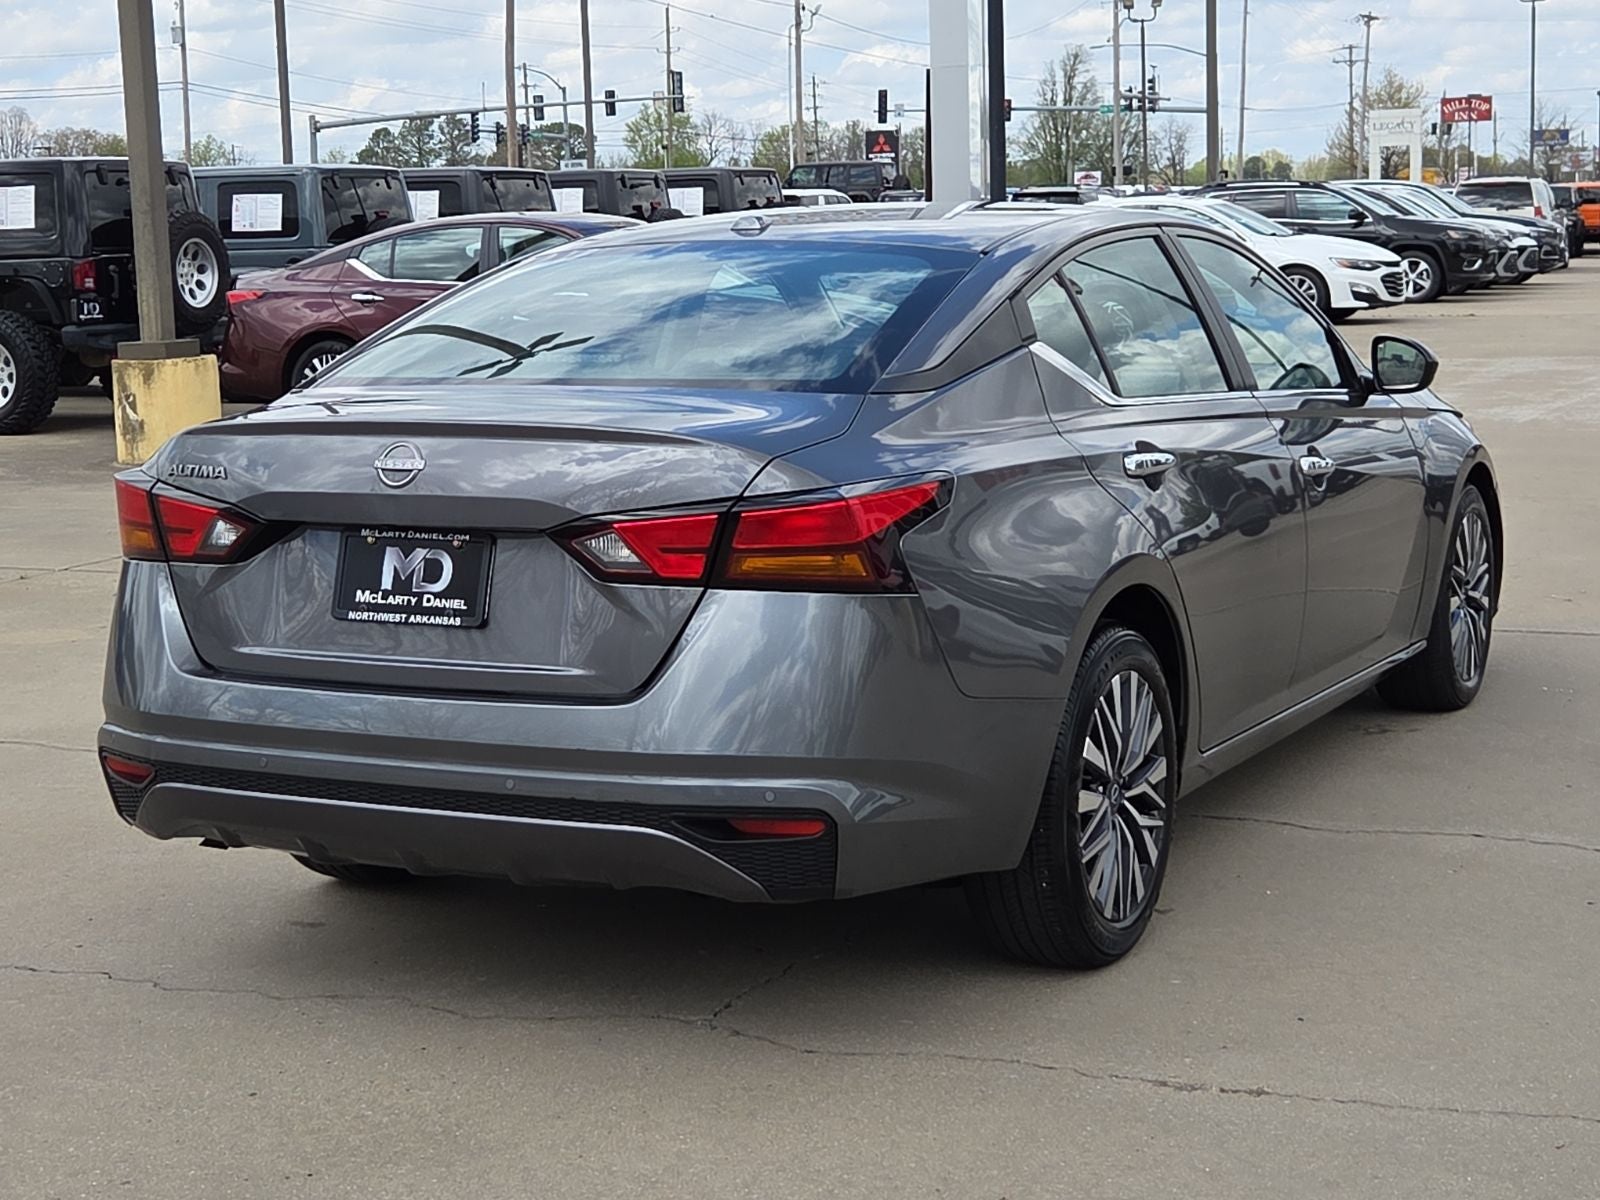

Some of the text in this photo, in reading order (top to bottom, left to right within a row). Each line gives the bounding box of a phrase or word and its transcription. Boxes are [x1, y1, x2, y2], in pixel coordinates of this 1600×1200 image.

[1443, 99, 1490, 113] HILL TOP
[1454, 111, 1477, 120] INN
[168, 463, 227, 479] ALTIMA
[375, 459, 425, 470] NISSAN
[381, 546, 453, 592] MD
[422, 594, 467, 609] DANIEL
[348, 611, 461, 626] NORTHWEST ARKANSAS
